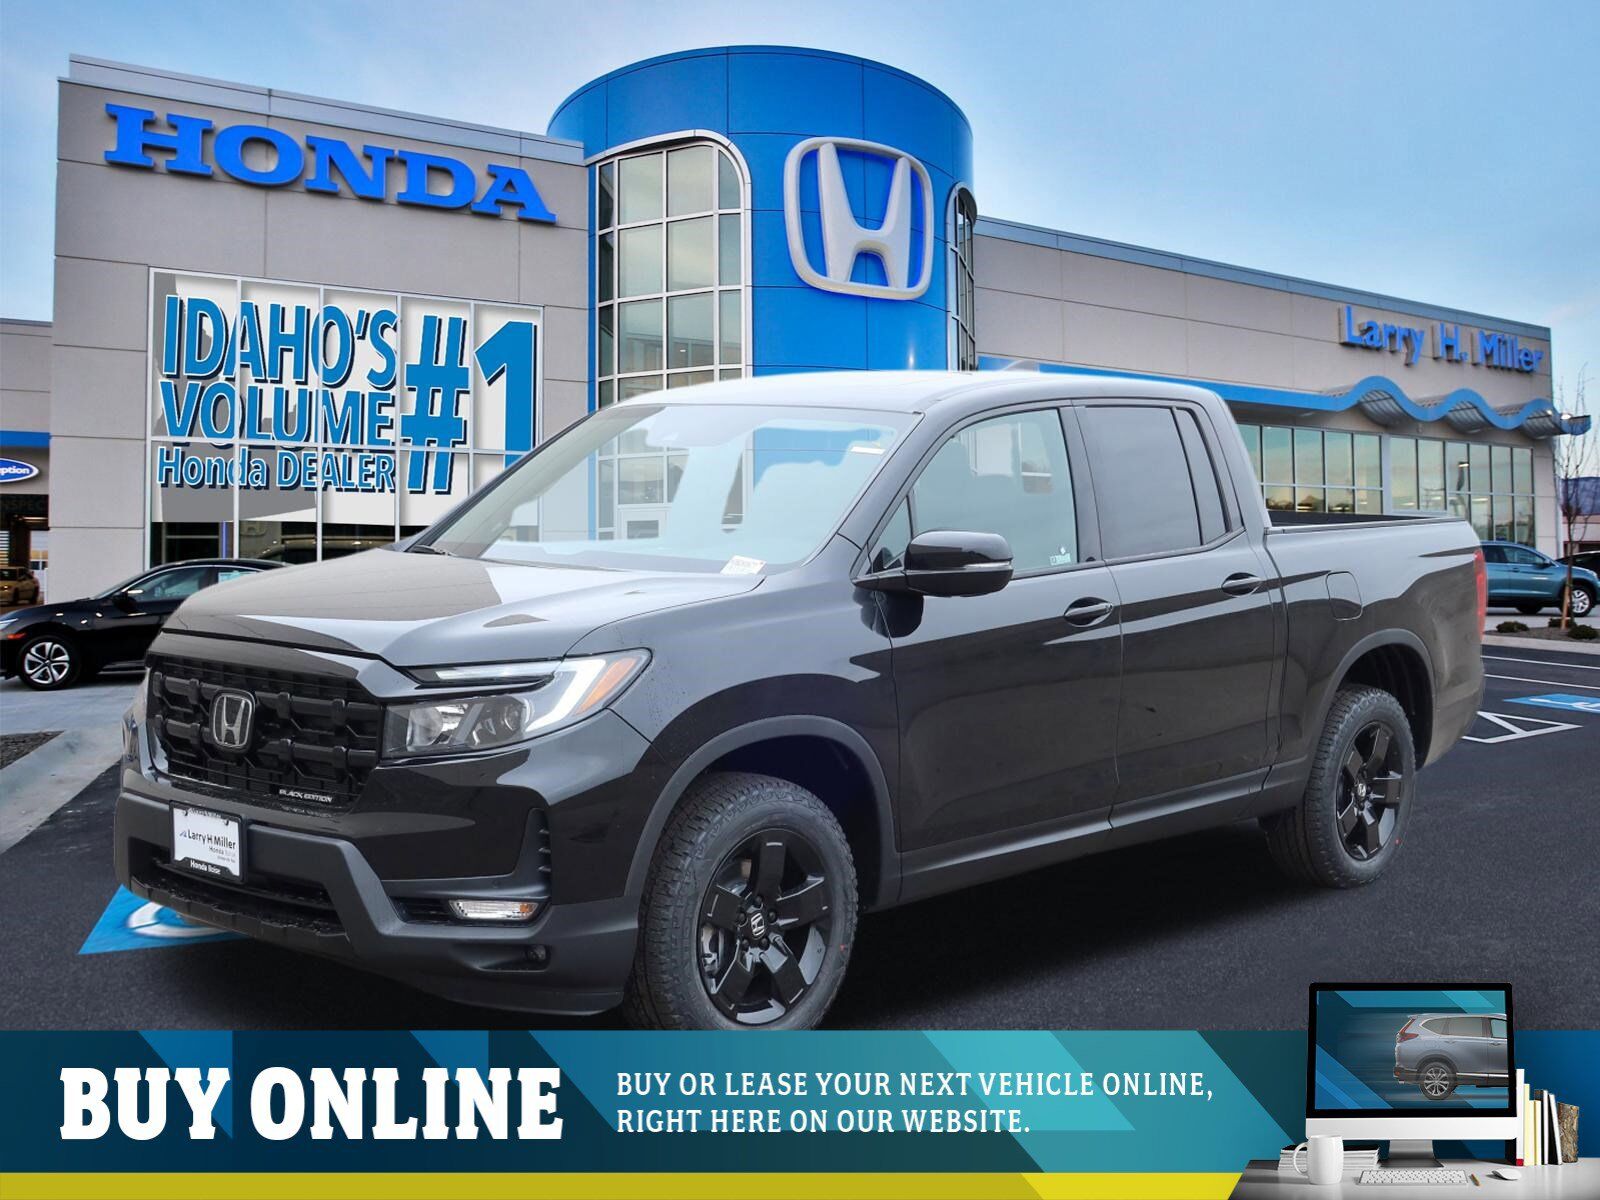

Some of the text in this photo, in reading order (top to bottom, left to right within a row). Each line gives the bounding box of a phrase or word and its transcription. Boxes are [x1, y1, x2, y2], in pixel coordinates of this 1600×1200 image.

[105, 103, 558, 224] HONDA
[162, 294, 398, 389] IDAHO'S
[1342, 306, 1544, 373] Larry H. Miller
[159, 379, 398, 447] VOLUME
[400, 314, 537, 494] #1
[157, 445, 397, 493] Honda DEALER
[279, 788, 333, 803] BLACK EDITION
[187, 829, 236, 849] Larry H Miller
[190, 859, 208, 871] Honda
